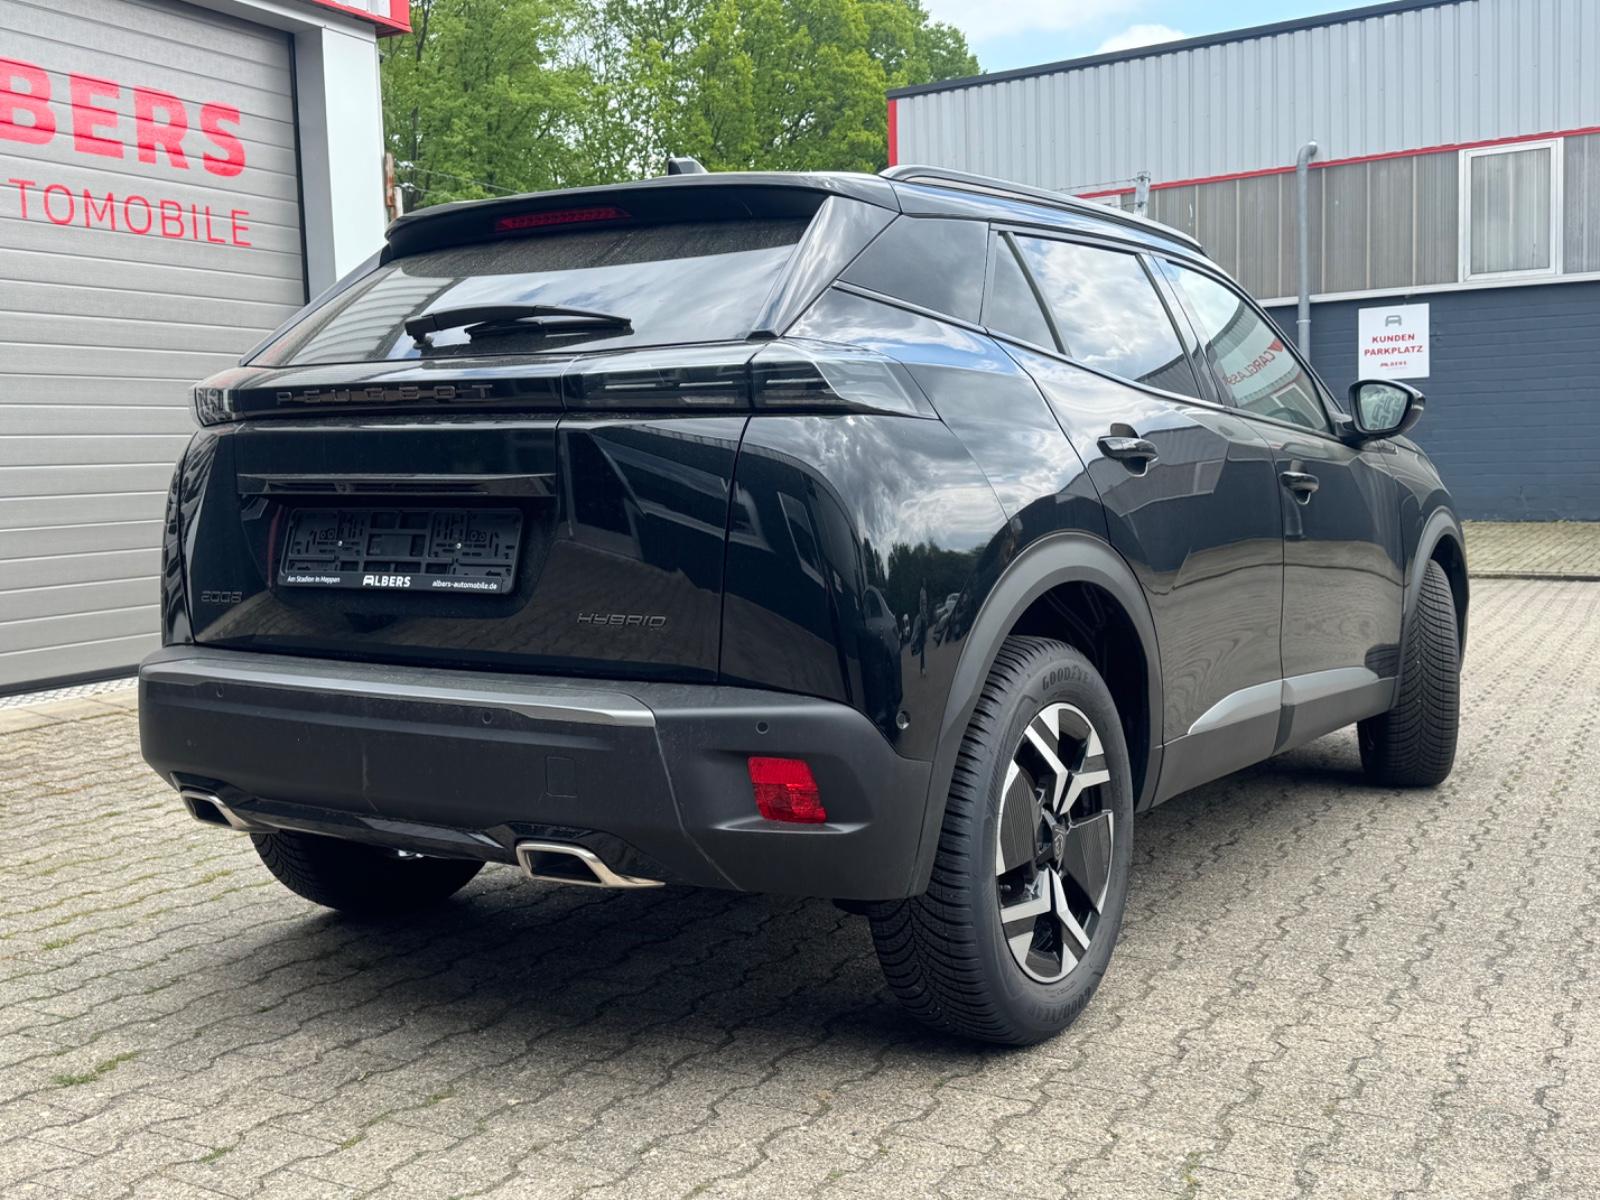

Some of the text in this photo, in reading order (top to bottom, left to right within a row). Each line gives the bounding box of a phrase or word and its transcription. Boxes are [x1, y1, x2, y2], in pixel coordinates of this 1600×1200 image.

[8, 178, 253, 247] TOMOBILE
[1371, 333, 1415, 344] KUNDEN
[1363, 344, 1424, 357] PARKPLATZ
[276, 384, 494, 405] PEUGEOT
[362, 574, 411, 588] ALBERS
[432, 578, 498, 591] albers-automobile.de
[577, 613, 666, 627] HYBRID
